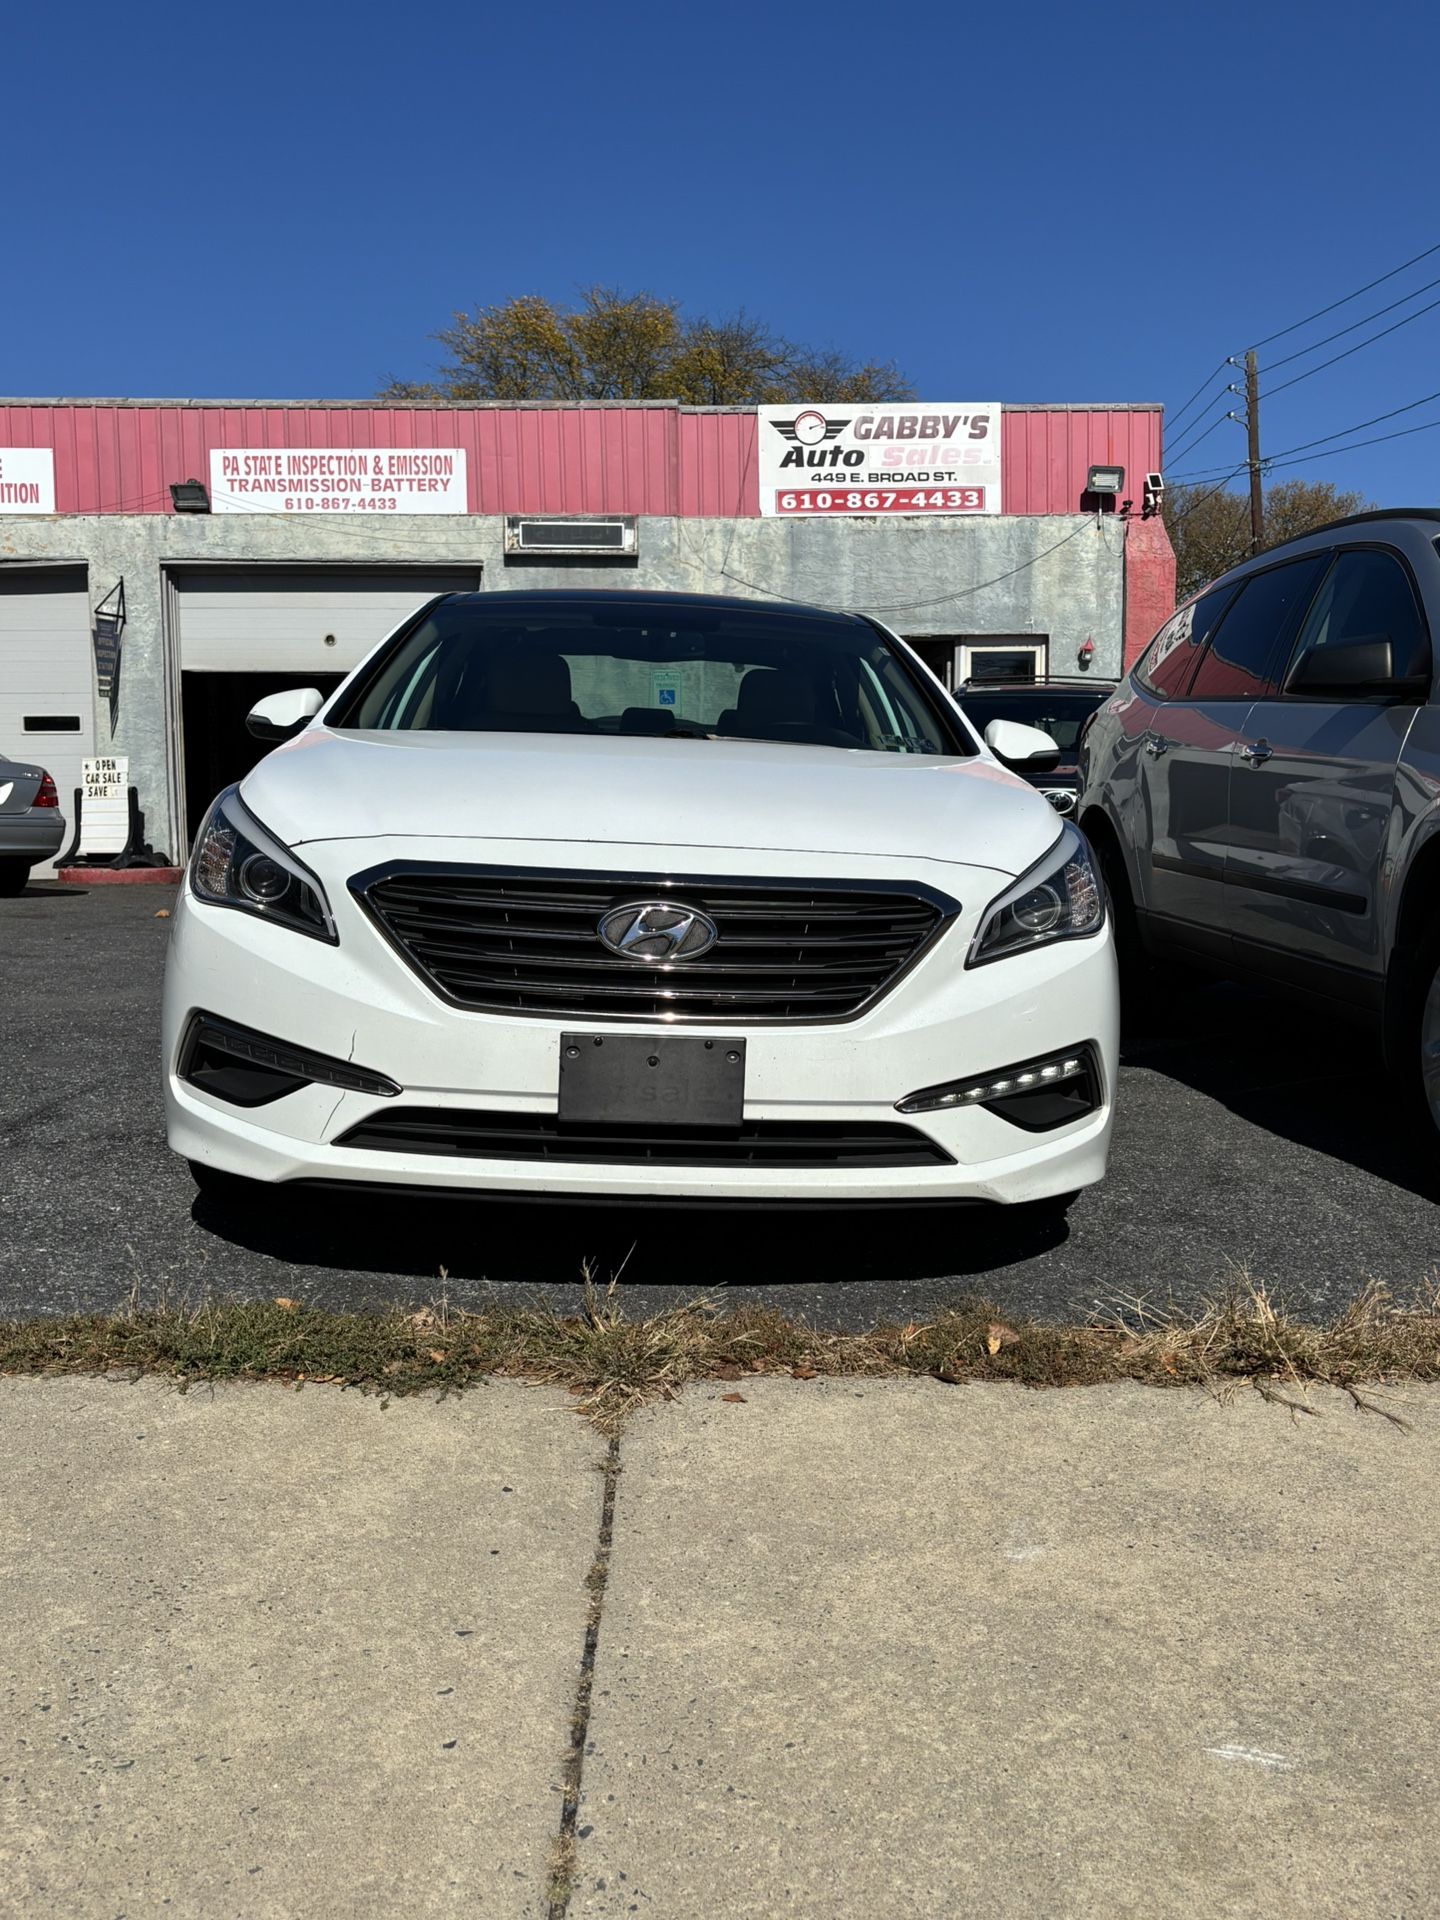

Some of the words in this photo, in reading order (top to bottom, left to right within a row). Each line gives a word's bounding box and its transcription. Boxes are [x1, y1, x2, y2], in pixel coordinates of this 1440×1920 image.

[853, 415, 990, 440] GABBY'S
[779, 445, 865, 468] Auto
[881, 445, 983, 467] Sales
[222, 455, 240, 476] PA
[244, 455, 282, 476] STATE
[287, 455, 368, 476] INSPECTION
[373, 455, 384, 476] &
[388, 455, 453, 476] EMISSION
[811, 473, 846, 483] 449
[850, 473, 865, 483] E.
[868, 472, 930, 483] BROAD
[933, 471, 958, 482] ST.
[284, 497, 397, 510] 610-867-4433
[781, 491, 979, 509] 610-867-4433
[85, 773, 100, 784] CAR
[102, 772, 122, 784] SALE
[88, 785, 108, 797] SAVE
